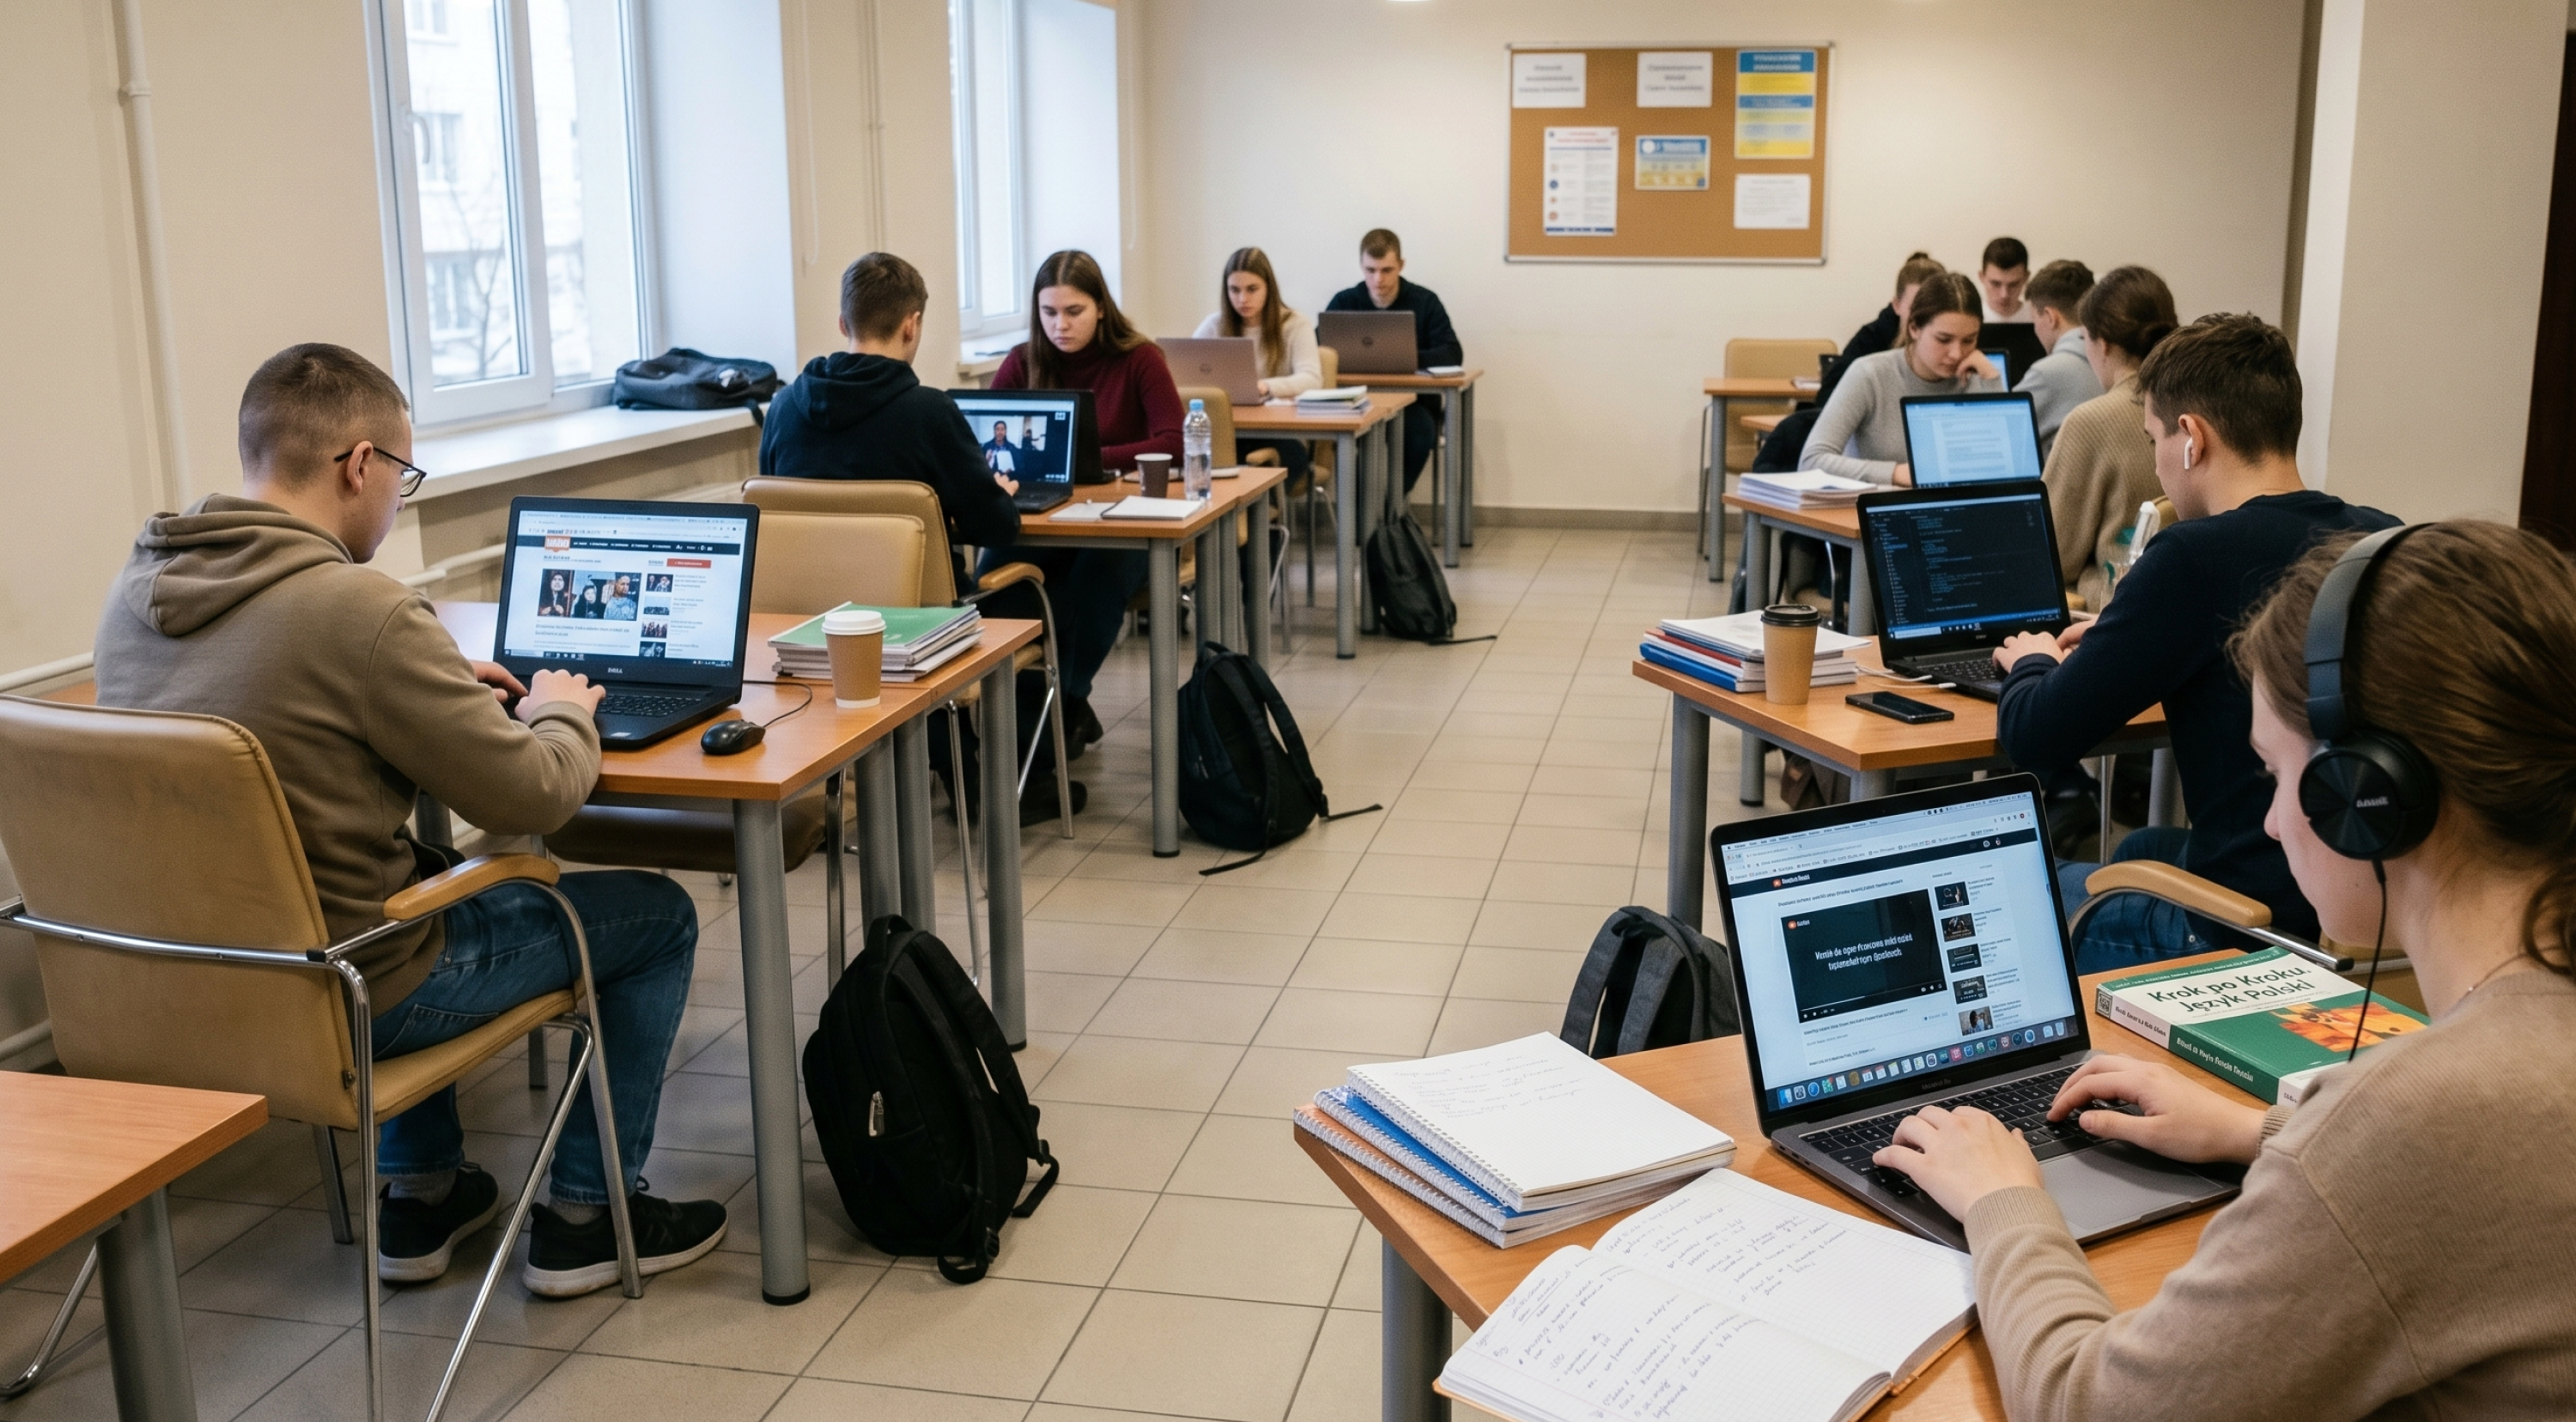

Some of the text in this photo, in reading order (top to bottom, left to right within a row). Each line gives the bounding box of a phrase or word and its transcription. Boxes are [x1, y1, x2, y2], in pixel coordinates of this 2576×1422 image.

[2148, 986, 2204, 1002] Krok
[2206, 981, 2238, 994] po
[2179, 994, 2246, 1012] Język
